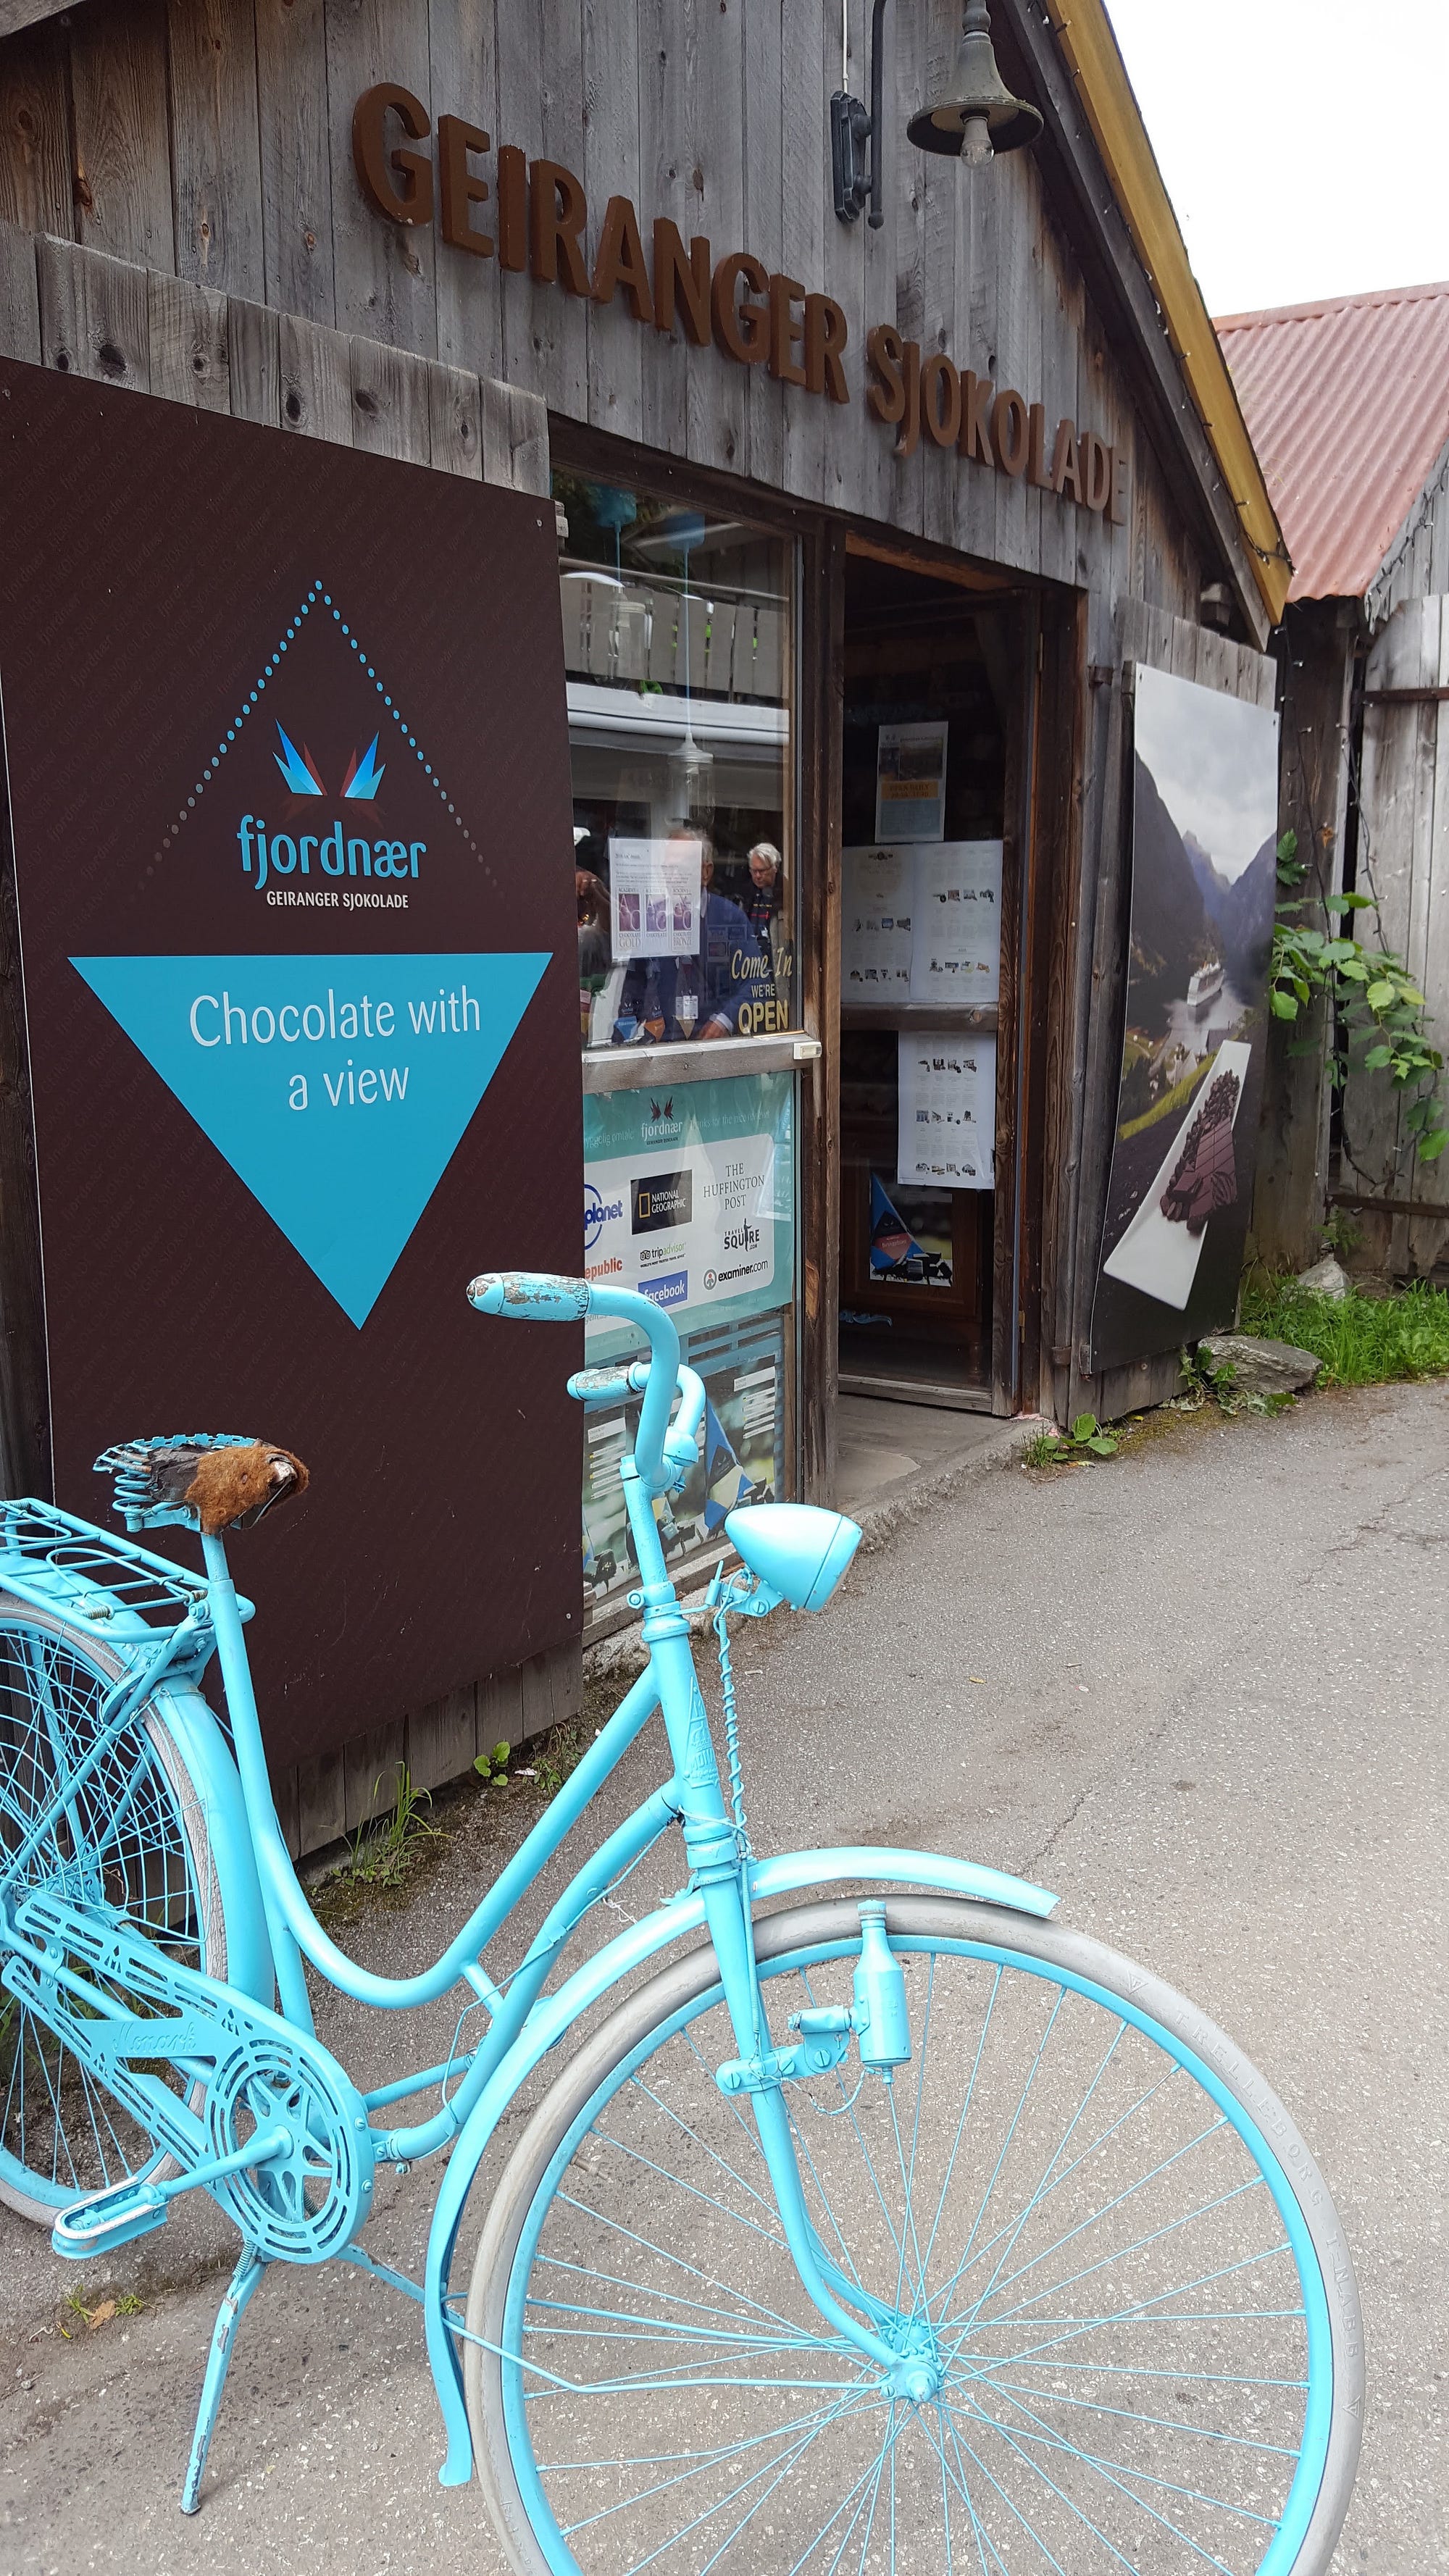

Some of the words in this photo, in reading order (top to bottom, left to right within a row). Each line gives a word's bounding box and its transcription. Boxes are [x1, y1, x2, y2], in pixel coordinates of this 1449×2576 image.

[352, 82, 850, 405] GEIRANGER
[868, 323, 1127, 527] SJOKOLADE
[236, 814, 427, 890] fjordnær
[266, 890, 340, 908] GEIRANGER
[343, 892, 409, 911] SJOKOLADE
[619, 937, 640, 948] GOLD
[731, 949, 769, 980] Come
[774, 947, 793, 978] In
[751, 984, 776, 998] WE'RE
[190, 988, 396, 1047] Chocolate
[408, 984, 481, 1034] with
[738, 999, 788, 1034] OPEN
[288, 1074, 309, 1111] a
[323, 1058, 410, 1107] view
[640, 1119, 683, 1142] fjordnær
[725, 1162, 745, 1178] THE
[652, 1189, 680, 1203] NATIONAL
[703, 1174, 765, 1198] HUFFINGTON
[651, 1197, 687, 1214] GEOGRAPHIC
[724, 1194, 747, 1210] POST
[584, 1200, 623, 1231] planet
[724, 1228, 743, 1237] TRAVEL
[717, 1260, 769, 1282] examiner.com
[112, 2021, 196, 2054] Monark
[1174, 2010, 1324, 2207] TRELLEBORG
